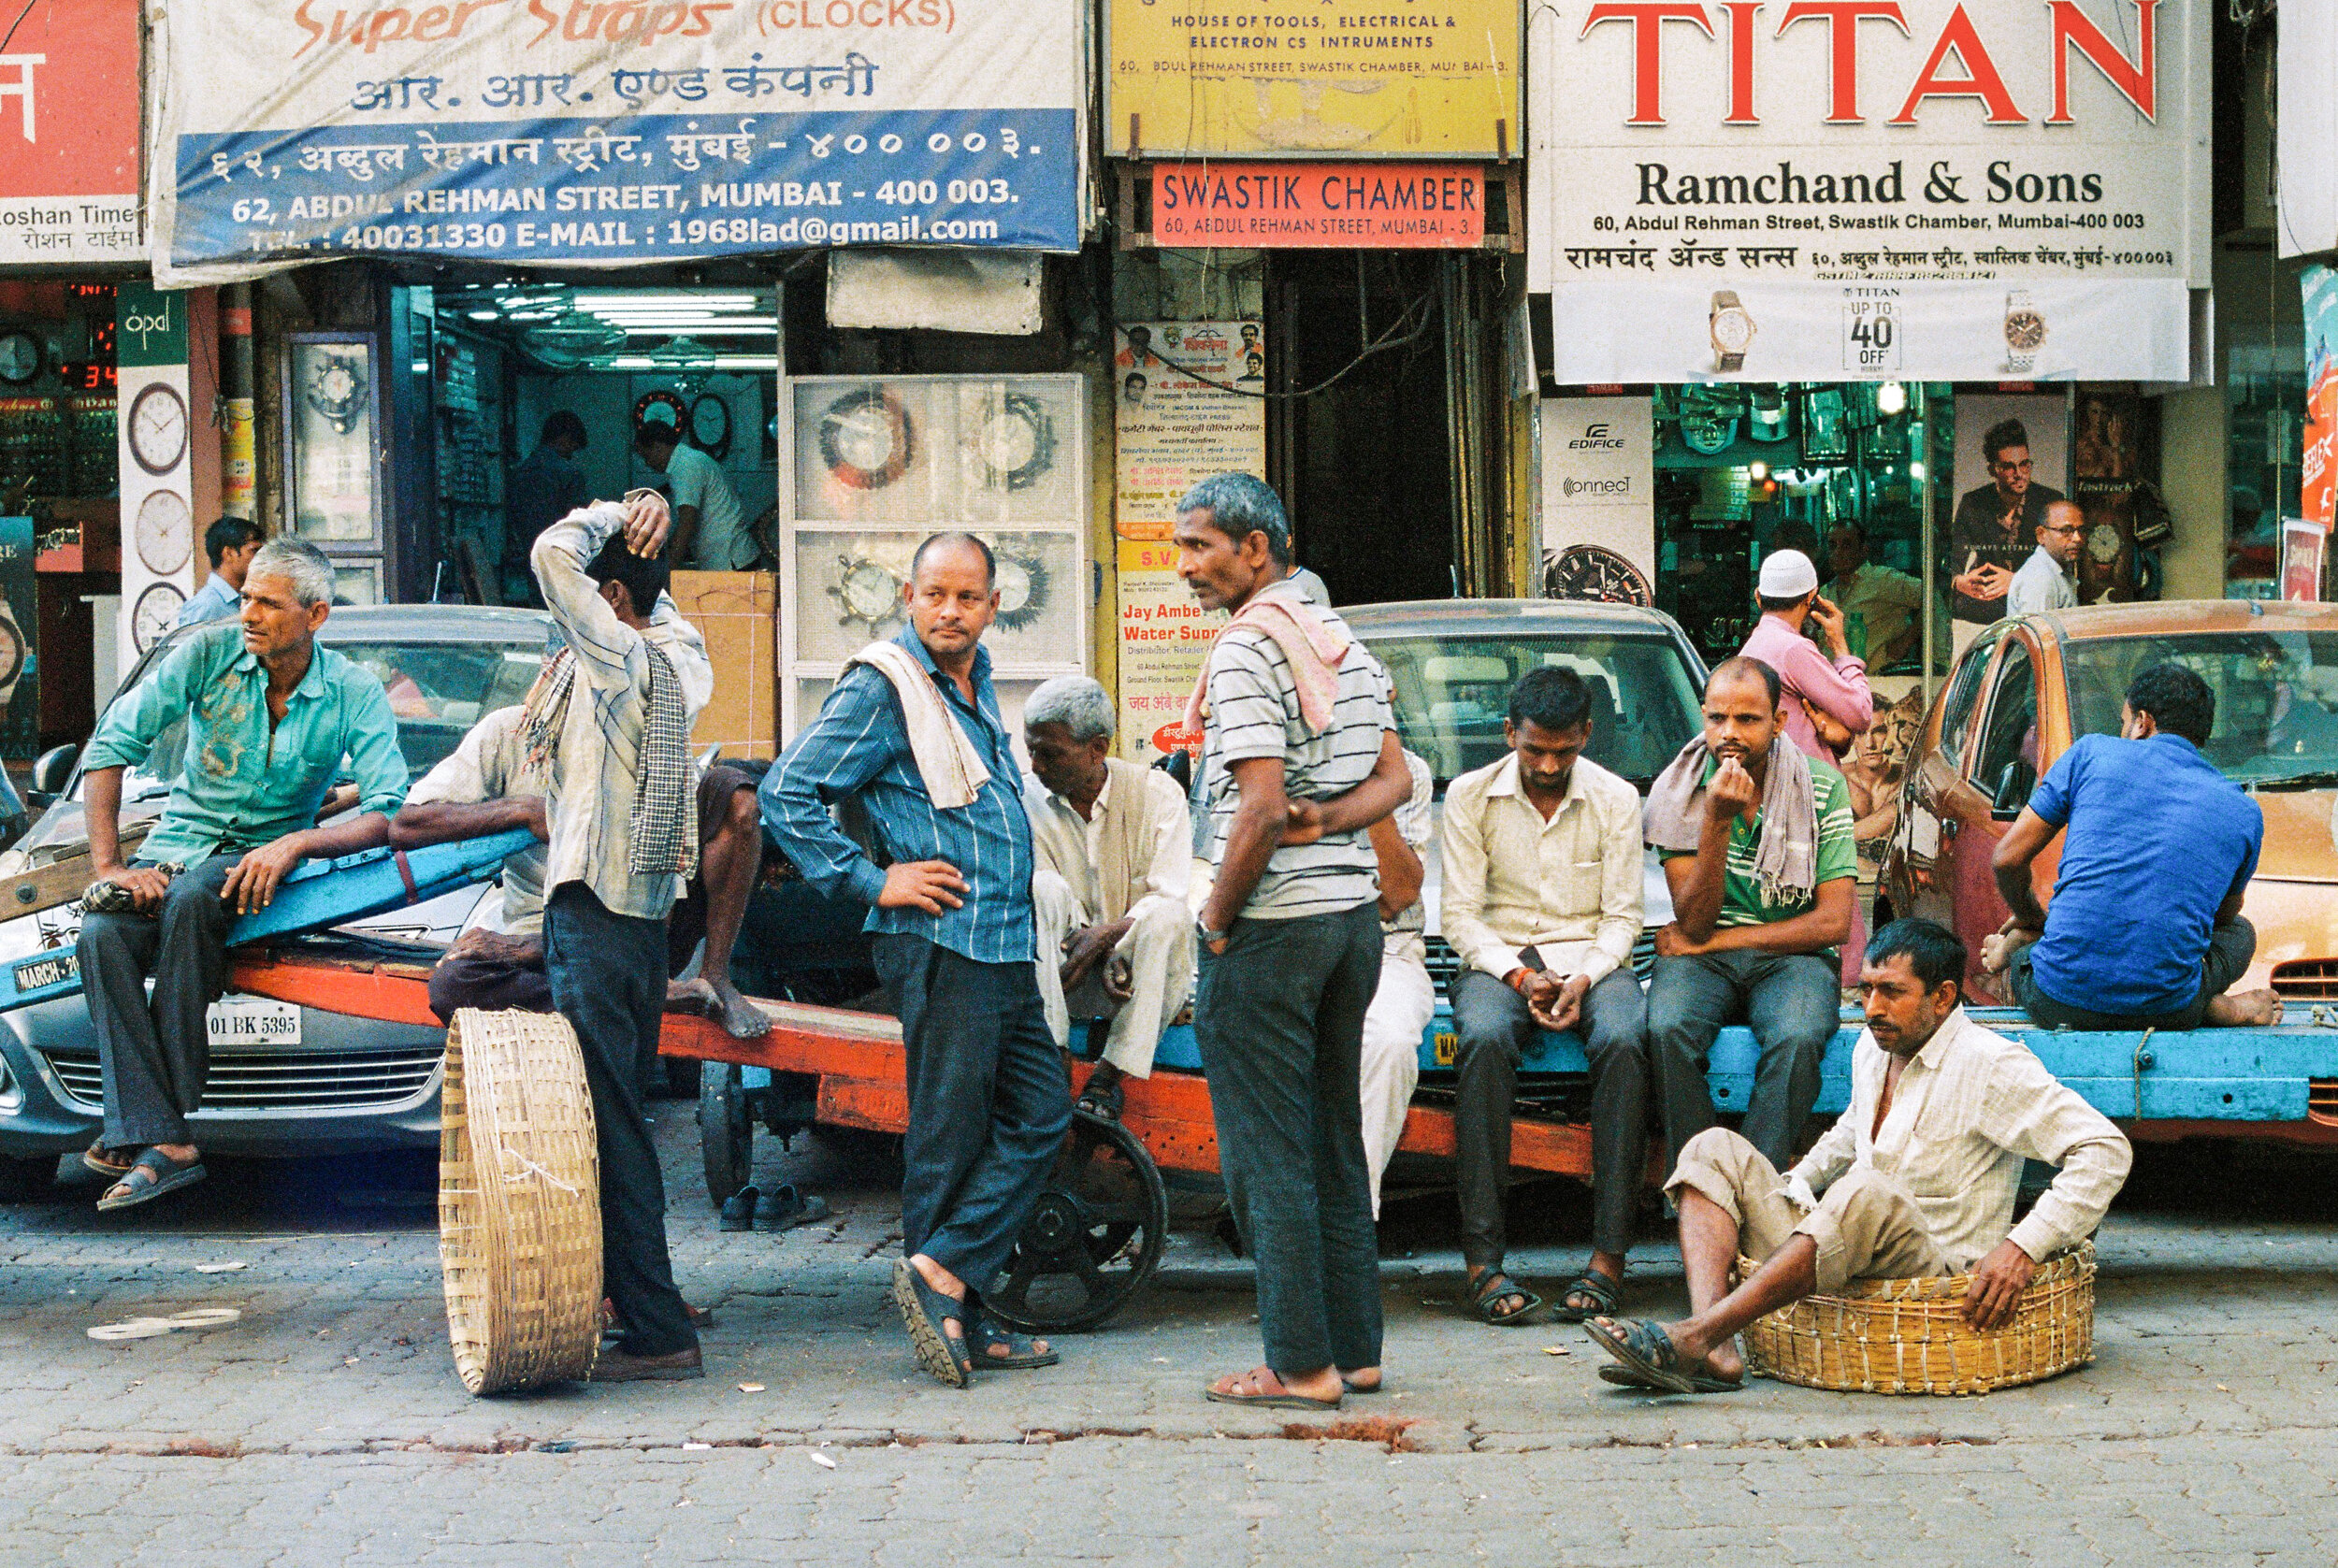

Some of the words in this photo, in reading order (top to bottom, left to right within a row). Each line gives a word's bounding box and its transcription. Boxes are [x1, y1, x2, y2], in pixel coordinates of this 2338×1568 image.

[293, 0, 507, 59] Super
[527, 0, 733, 50] Straps
[757, 0, 955, 36] (CLOCKS)
[1172, 15, 1229, 27] HOUSE
[1236, 15, 1257, 27] OF
[1264, 15, 1325, 29] TOOLS,
[1339, 15, 1439, 27] ELECTRICAL
[1446, 16, 1456, 27] &
[1321, 36, 1434, 48] INTRUMENTS
[1119, 60, 1139, 73] 60,
[1153, 62, 1187, 72] BDUL
[1191, 62, 1246, 72] REHMAN
[1249, 63, 1294, 74] STREET,
[1300, 62, 1354, 73] SWASTIK
[1360, 62, 1425, 73] CHAMBER,
[1580, 0, 2161, 124] TITAN
[351, 76, 461, 111] आर.
[482, 73, 594, 108] आर.
[611, 68, 710, 110] एण्ड
[722, 51, 879, 98] कंपनी
[298, 144, 409, 181] अब्दुल
[416, 130, 543, 172] रेहमान
[553, 125, 652, 172] स्ट्रीट,
[666, 118, 756, 170] मुंबई
[1163, 175, 1302, 210] SWASTIK
[1321, 176, 1477, 211] CHAMBER
[1636, 160, 1906, 206] Ramchand
[1924, 161, 1969, 204] &
[1987, 161, 2102, 205] Sons
[232, 197, 277, 225] 62,
[288, 193, 394, 221] ABDUL
[404, 187, 545, 215] REHMAN
[556, 185, 689, 213] STREET,
[701, 181, 842, 208] MUMBAI
[875, 180, 938, 205] 400
[947, 180, 1018, 204] 003.
[0, 207, 71, 226] oshan
[79, 205, 134, 224] Time
[1594, 216, 1620, 233] 60,
[1624, 215, 1678, 231] Abdul
[1685, 215, 1759, 230] Rehman
[1766, 215, 1824, 232] Street,
[1828, 214, 1899, 229] Swastik
[1905, 214, 1991, 231] Chamber,
[1999, 214, 2107, 229] Mumbai-400
[2113, 214, 2144, 229] 003
[249, 231, 310, 252] TEL.
[341, 223, 506, 250] 40031330
[516, 222, 636, 247] E-MAIL
[668, 216, 997, 246] 1968lad@gmail.com
[1165, 218, 1187, 236] 60,
[1193, 217, 1244, 236] ABDUL
[1251, 218, 1315, 236] REHMAN
[1321, 218, 1376, 237] STREET,
[1380, 219, 1443, 237] MUMBAI
[1460, 219, 1474, 236] 3.
[22, 227, 73, 250] रोशन
[1565, 238, 1657, 271] रामचंद
[1737, 247, 1798, 268] सन्स
[1840, 250, 1880, 270] अब्दुल
[1883, 246, 1928, 266] रेहमान
[1973, 246, 2031, 266] स्वास्तिक
[1856, 288, 1899, 297] TITAN
[1851, 302, 1869, 314] UP
[1874, 302, 1892, 314] TO
[125, 296, 169, 351] opal
[1568, 439, 1625, 450] EDIFICE
[1123, 604, 1152, 622] Jay
[1156, 604, 1201, 619] Ambe
[1123, 626, 1176, 641] Water
[1128, 696, 1150, 712] जय
[20, 962, 58, 989] MARCH
[210, 1017, 227, 1034] 01
[233, 1016, 256, 1034] BK
[261, 1015, 296, 1034] 5395
